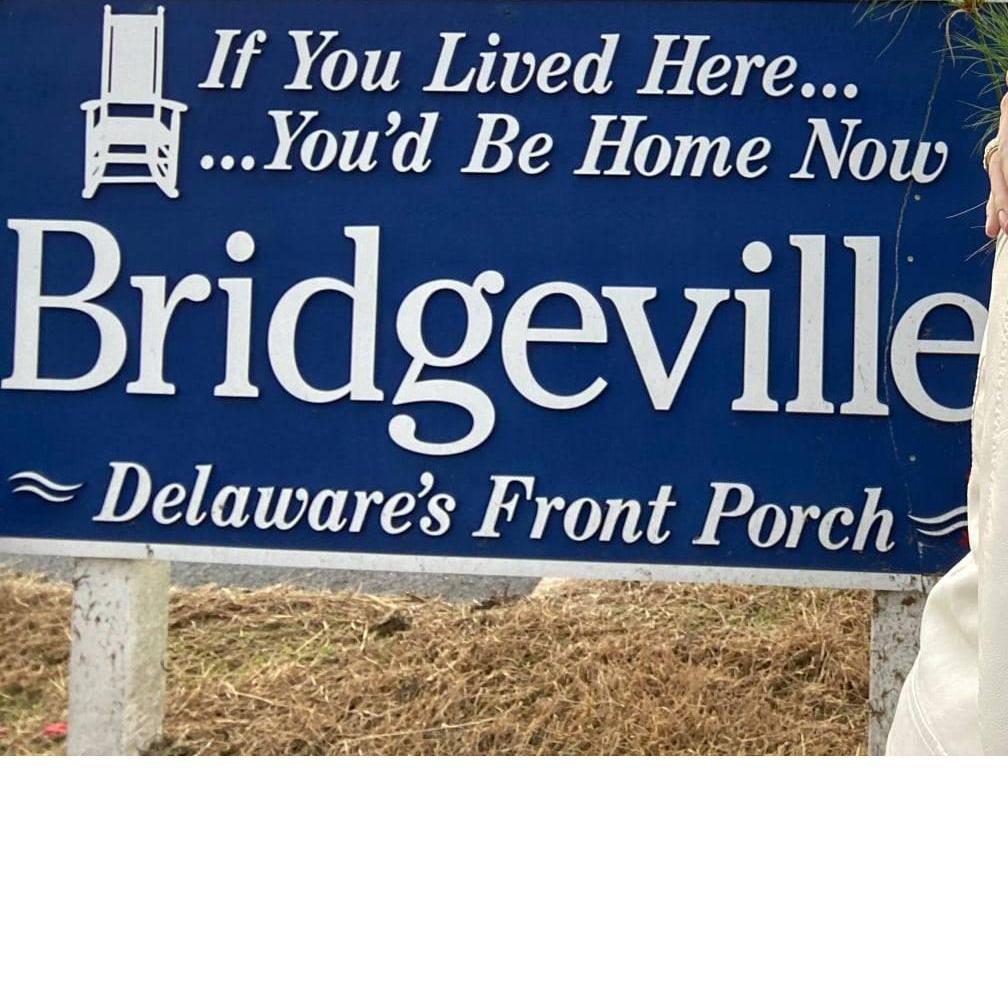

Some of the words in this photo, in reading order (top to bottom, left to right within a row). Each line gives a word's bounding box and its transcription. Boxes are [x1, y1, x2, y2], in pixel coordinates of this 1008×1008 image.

[198, 28, 267, 90] If
[284, 29, 400, 93] You
[422, 31, 620, 96] Lived
[637, 34, 859, 99] Here...
[200, 109, 440, 173] ...You'd
[460, 112, 554, 176] Be
[574, 114, 772, 179] Home
[789, 118, 949, 185] Now
[0, 218, 989, 456] Bridgeville
[92, 461, 457, 538] Delaware's
[472, 474, 677, 545] Front
[692, 480, 896, 554] Porch
